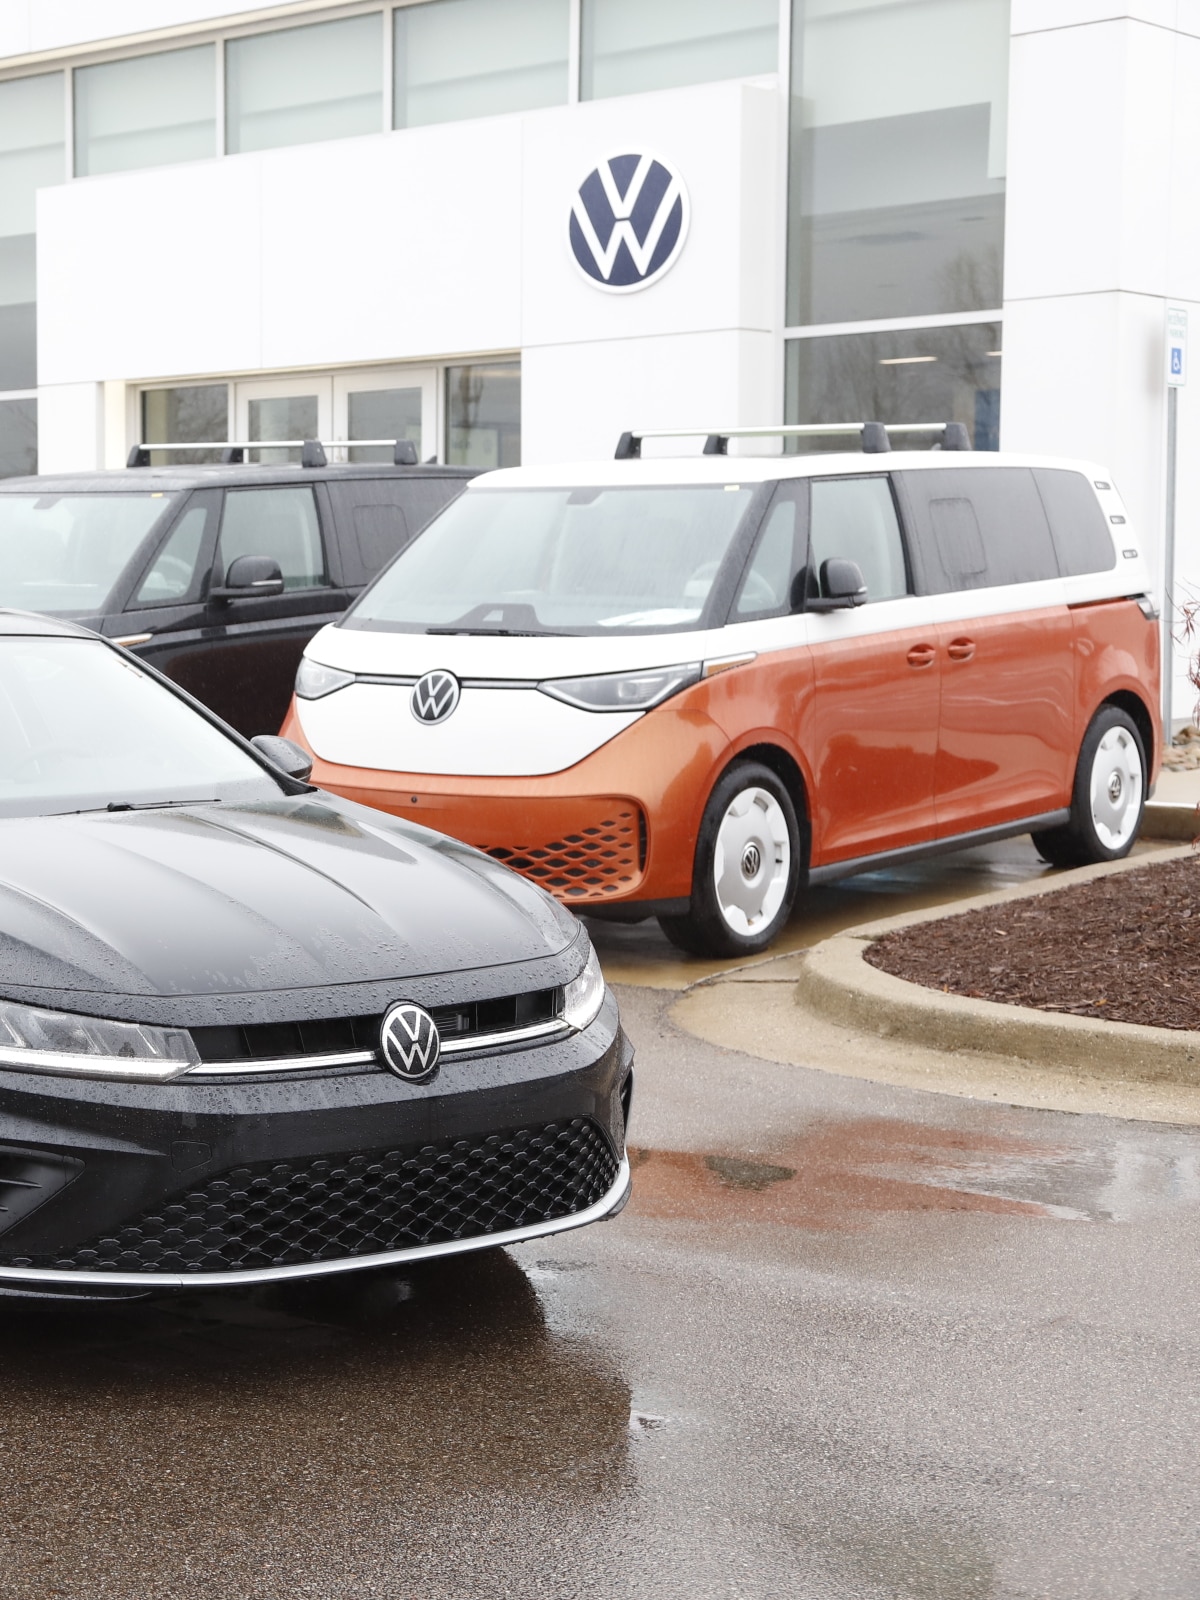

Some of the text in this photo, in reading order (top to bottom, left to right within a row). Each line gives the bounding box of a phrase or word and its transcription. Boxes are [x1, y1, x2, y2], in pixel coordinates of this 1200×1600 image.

[567, 152, 684, 288] VW
[410, 669, 460, 724] VW
[382, 1004, 439, 1078] VW
